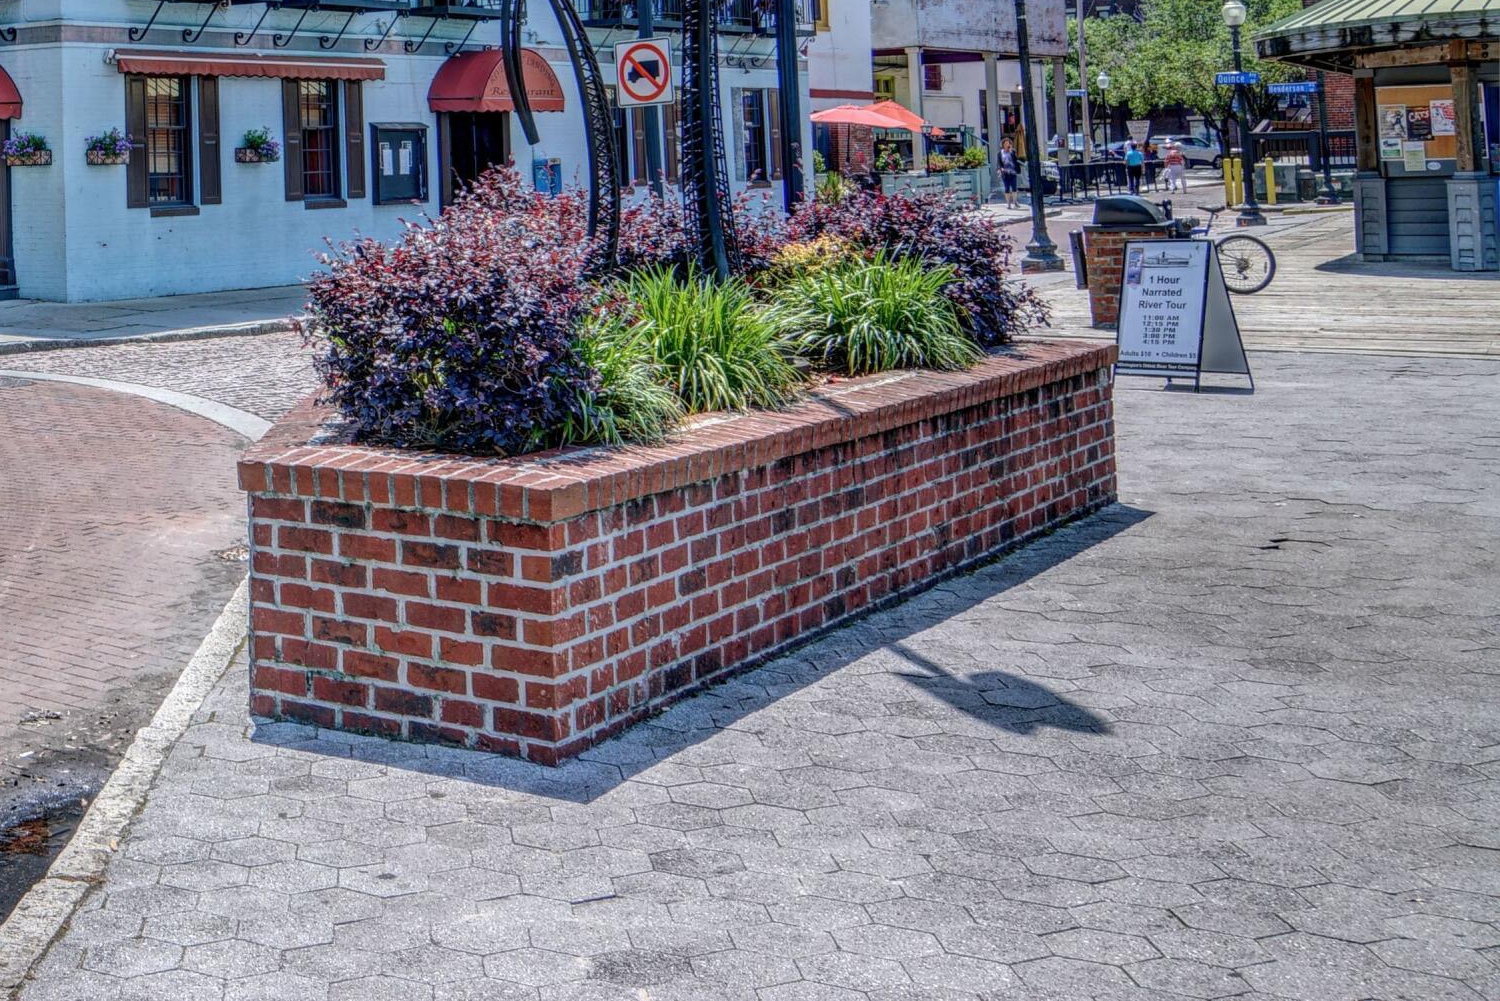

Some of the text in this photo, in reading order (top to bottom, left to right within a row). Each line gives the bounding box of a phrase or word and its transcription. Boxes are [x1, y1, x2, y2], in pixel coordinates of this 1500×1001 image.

[1218, 74, 1245, 83] Quince
[1268, 85, 1304, 93] Henderson
[1408, 110, 1429, 122] CATS
[1150, 275, 1180, 284] 1 Hour
[1142, 288, 1182, 297] Narrated
[1138, 300, 1187, 309] River Tour
